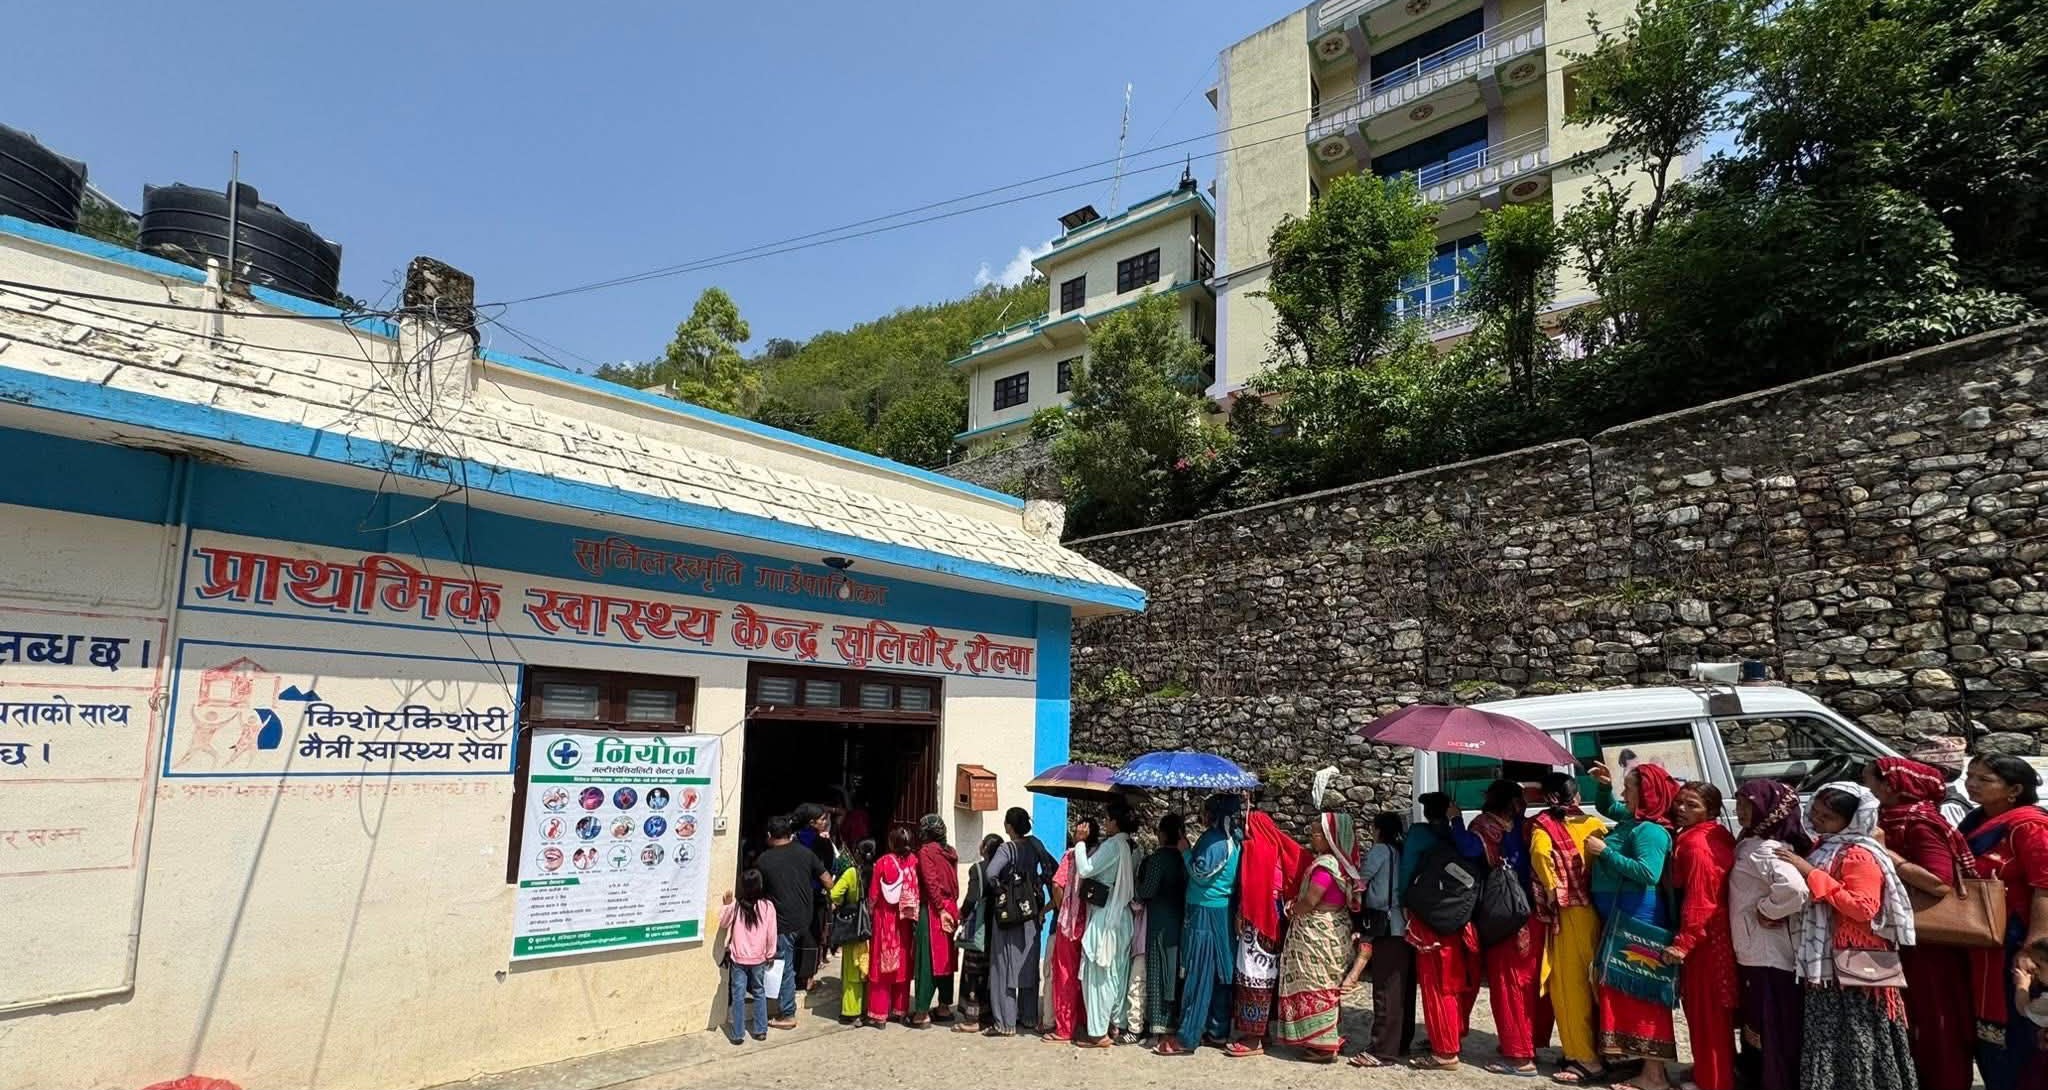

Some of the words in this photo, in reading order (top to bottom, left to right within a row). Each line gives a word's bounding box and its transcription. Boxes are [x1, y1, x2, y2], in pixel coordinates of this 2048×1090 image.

[193, 547, 504, 625] प्राथमिक
[523, 588, 722, 646] स्वास्थ्य
[89, 637, 130, 672] छ
[78, 704, 132, 728] साथ
[299, 733, 354, 760] मैत्री
[357, 740, 453, 762] स्वास्थ्य
[458, 737, 507, 763] सेवा
[595, 736, 696, 765] नियोन
